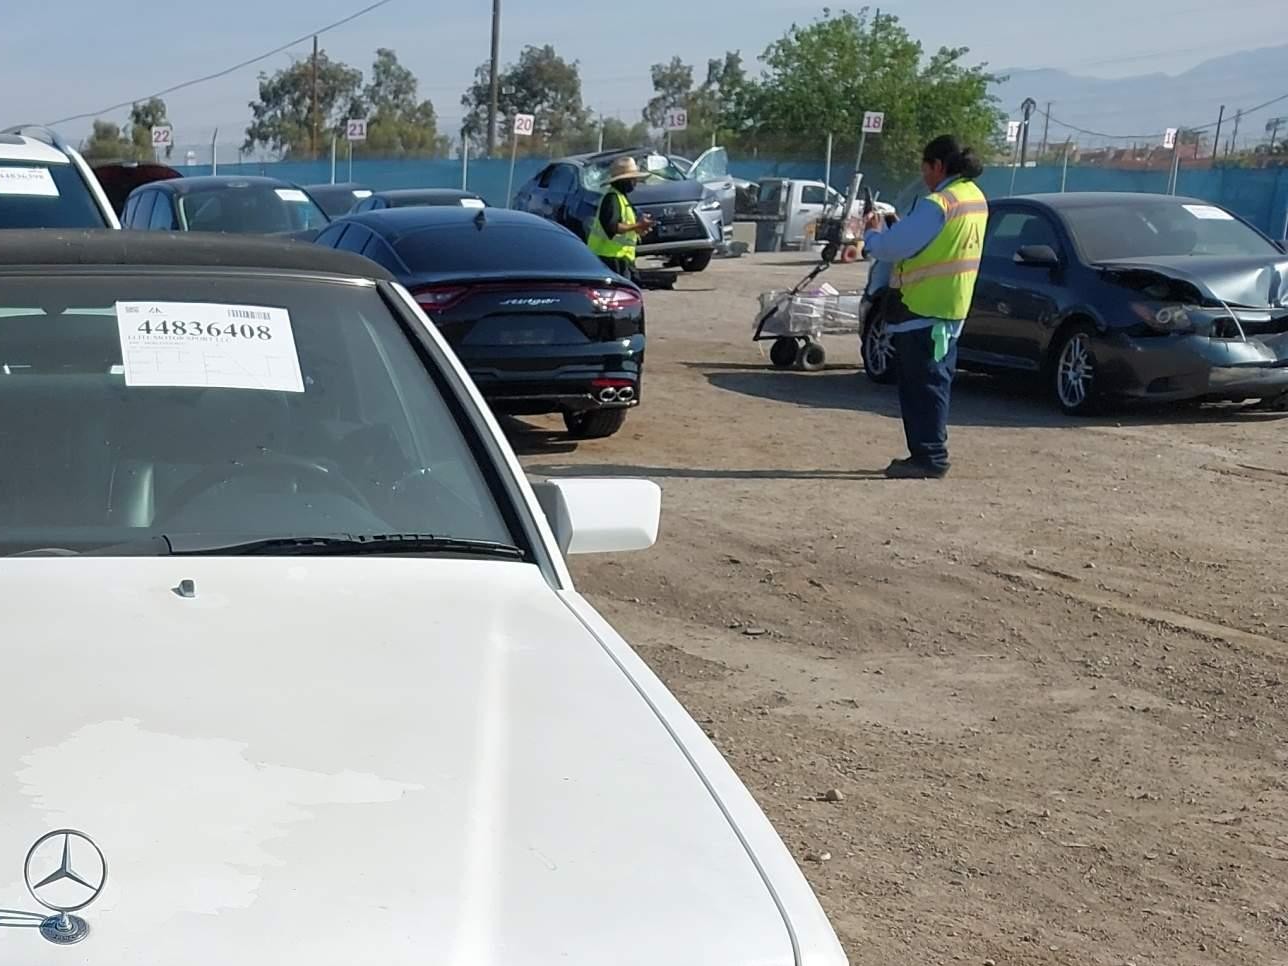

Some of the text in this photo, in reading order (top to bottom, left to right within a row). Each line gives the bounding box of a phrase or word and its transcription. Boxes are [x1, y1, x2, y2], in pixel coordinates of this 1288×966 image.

[515, 117, 532, 131] 20
[668, 113, 686, 128] 19
[863, 115, 882, 130] 18
[153, 129, 169, 143] 22
[348, 122, 364, 136] 21
[137, 319, 273, 341] 44836408
